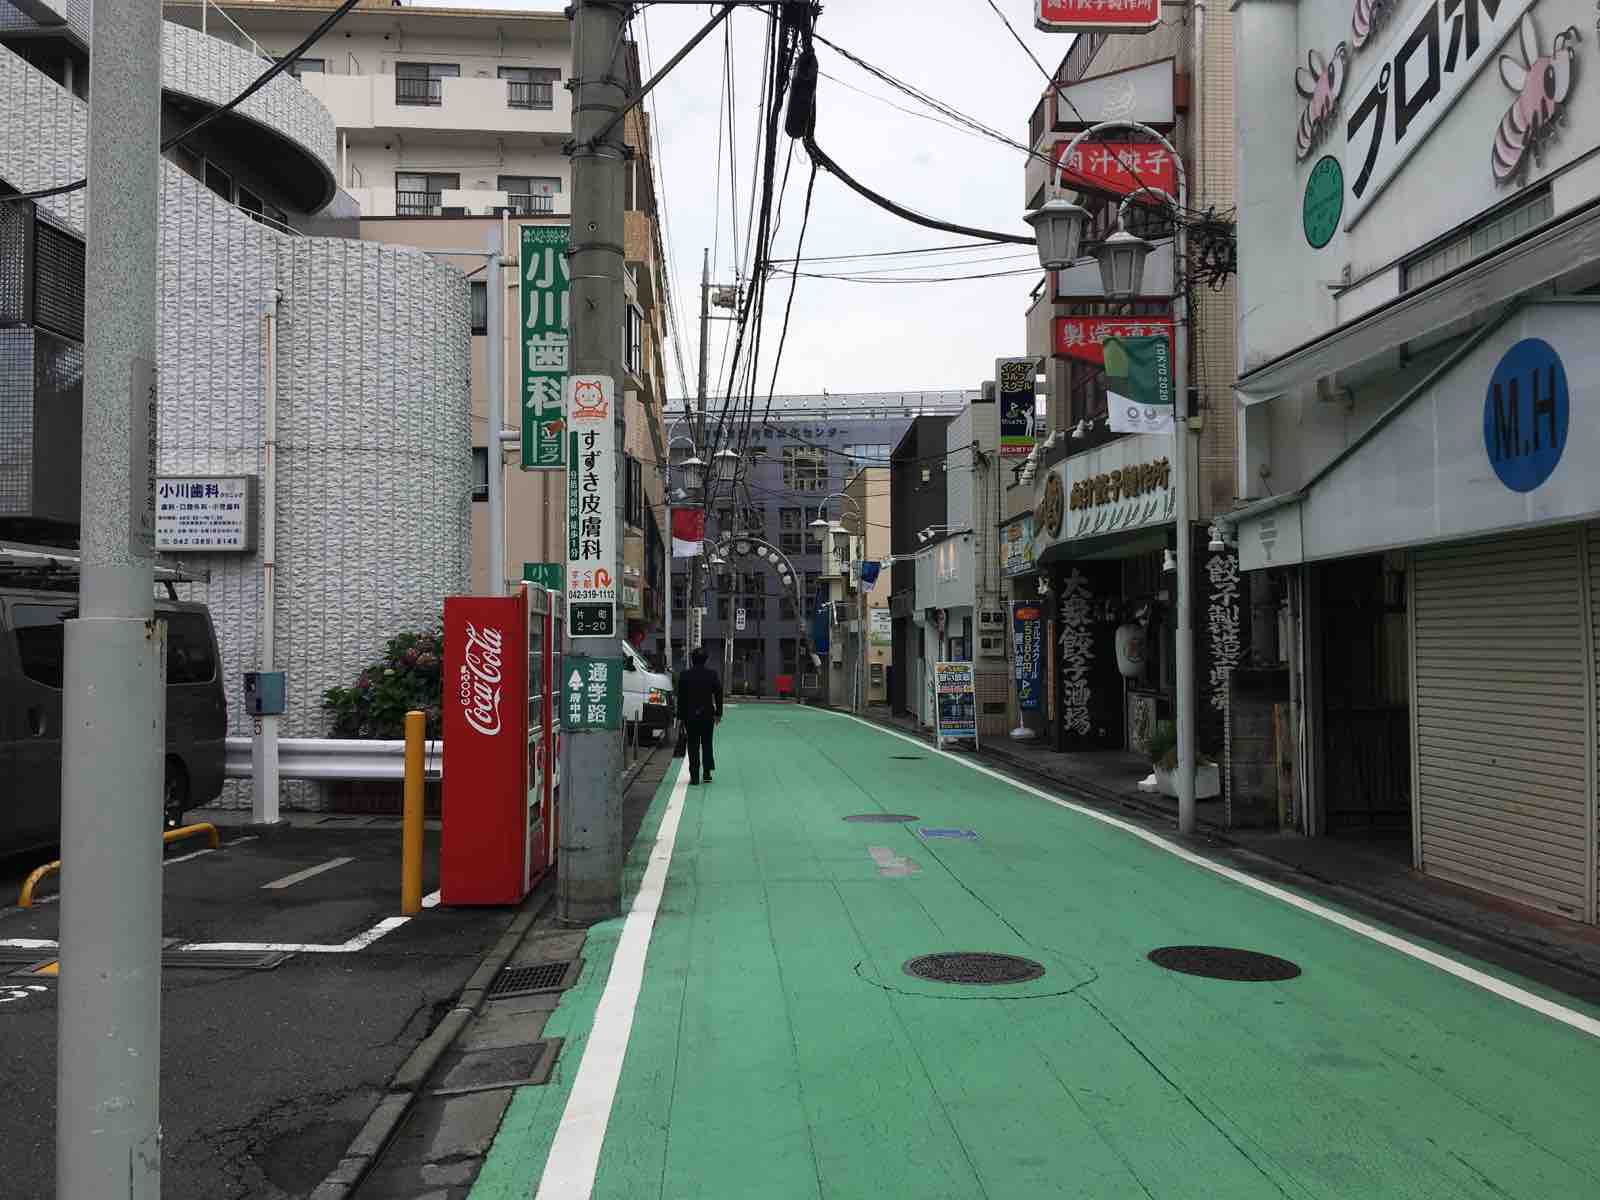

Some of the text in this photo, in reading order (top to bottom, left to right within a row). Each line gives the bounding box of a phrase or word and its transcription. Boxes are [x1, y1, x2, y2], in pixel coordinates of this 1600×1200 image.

[1156, 343, 1169, 401] TOKYO 2020
[159, 483, 219, 498] 小川歯科
[581, 429, 602, 561] すずき皮膚科
[576, 621, 607, 631] 2-20
[464, 620, 502, 736] Coca-Cola
[587, 662, 608, 723] 通学路
[570, 692, 582, 723] 府中市
